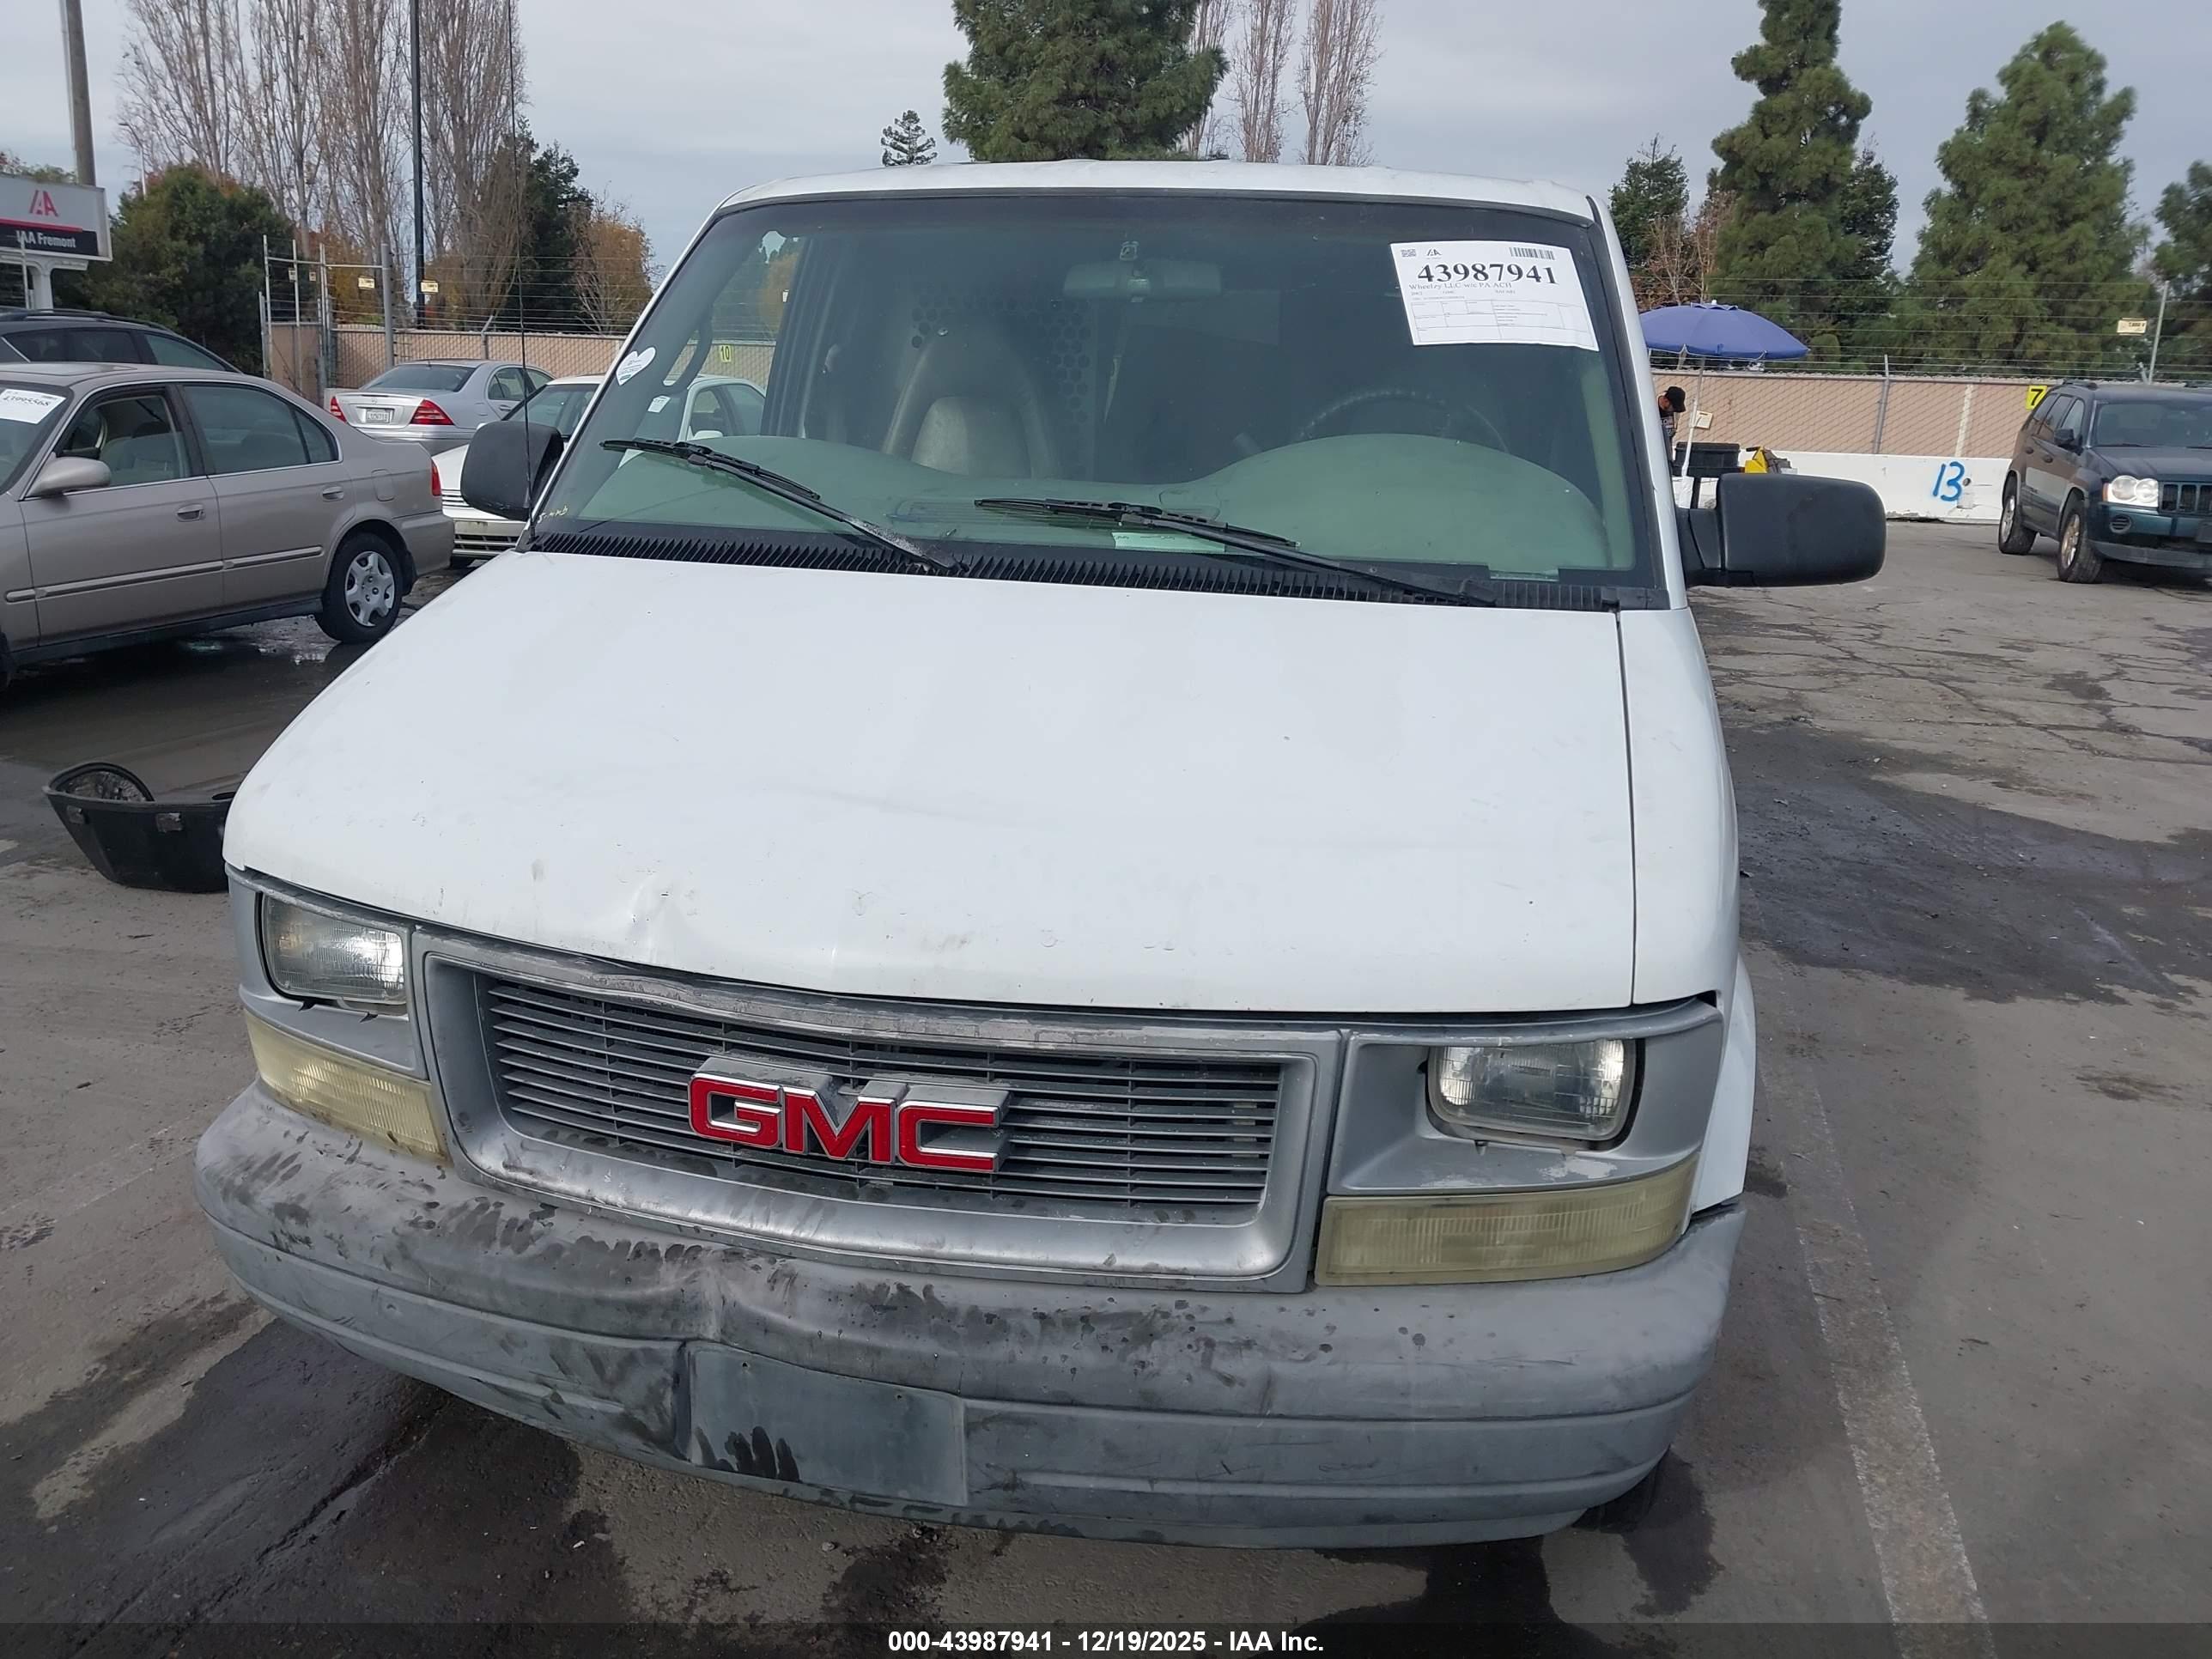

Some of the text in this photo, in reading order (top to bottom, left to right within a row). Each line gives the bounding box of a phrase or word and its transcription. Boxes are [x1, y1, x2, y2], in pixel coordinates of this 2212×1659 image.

[38, 232, 76, 248] Fremont
[1418, 263, 1559, 285] 43987941
[720, 345, 730, 361] 10
[2031, 388, 2044, 406] 7
[1932, 460, 1966, 501] 13
[687, 1056, 1013, 1174] GMC
